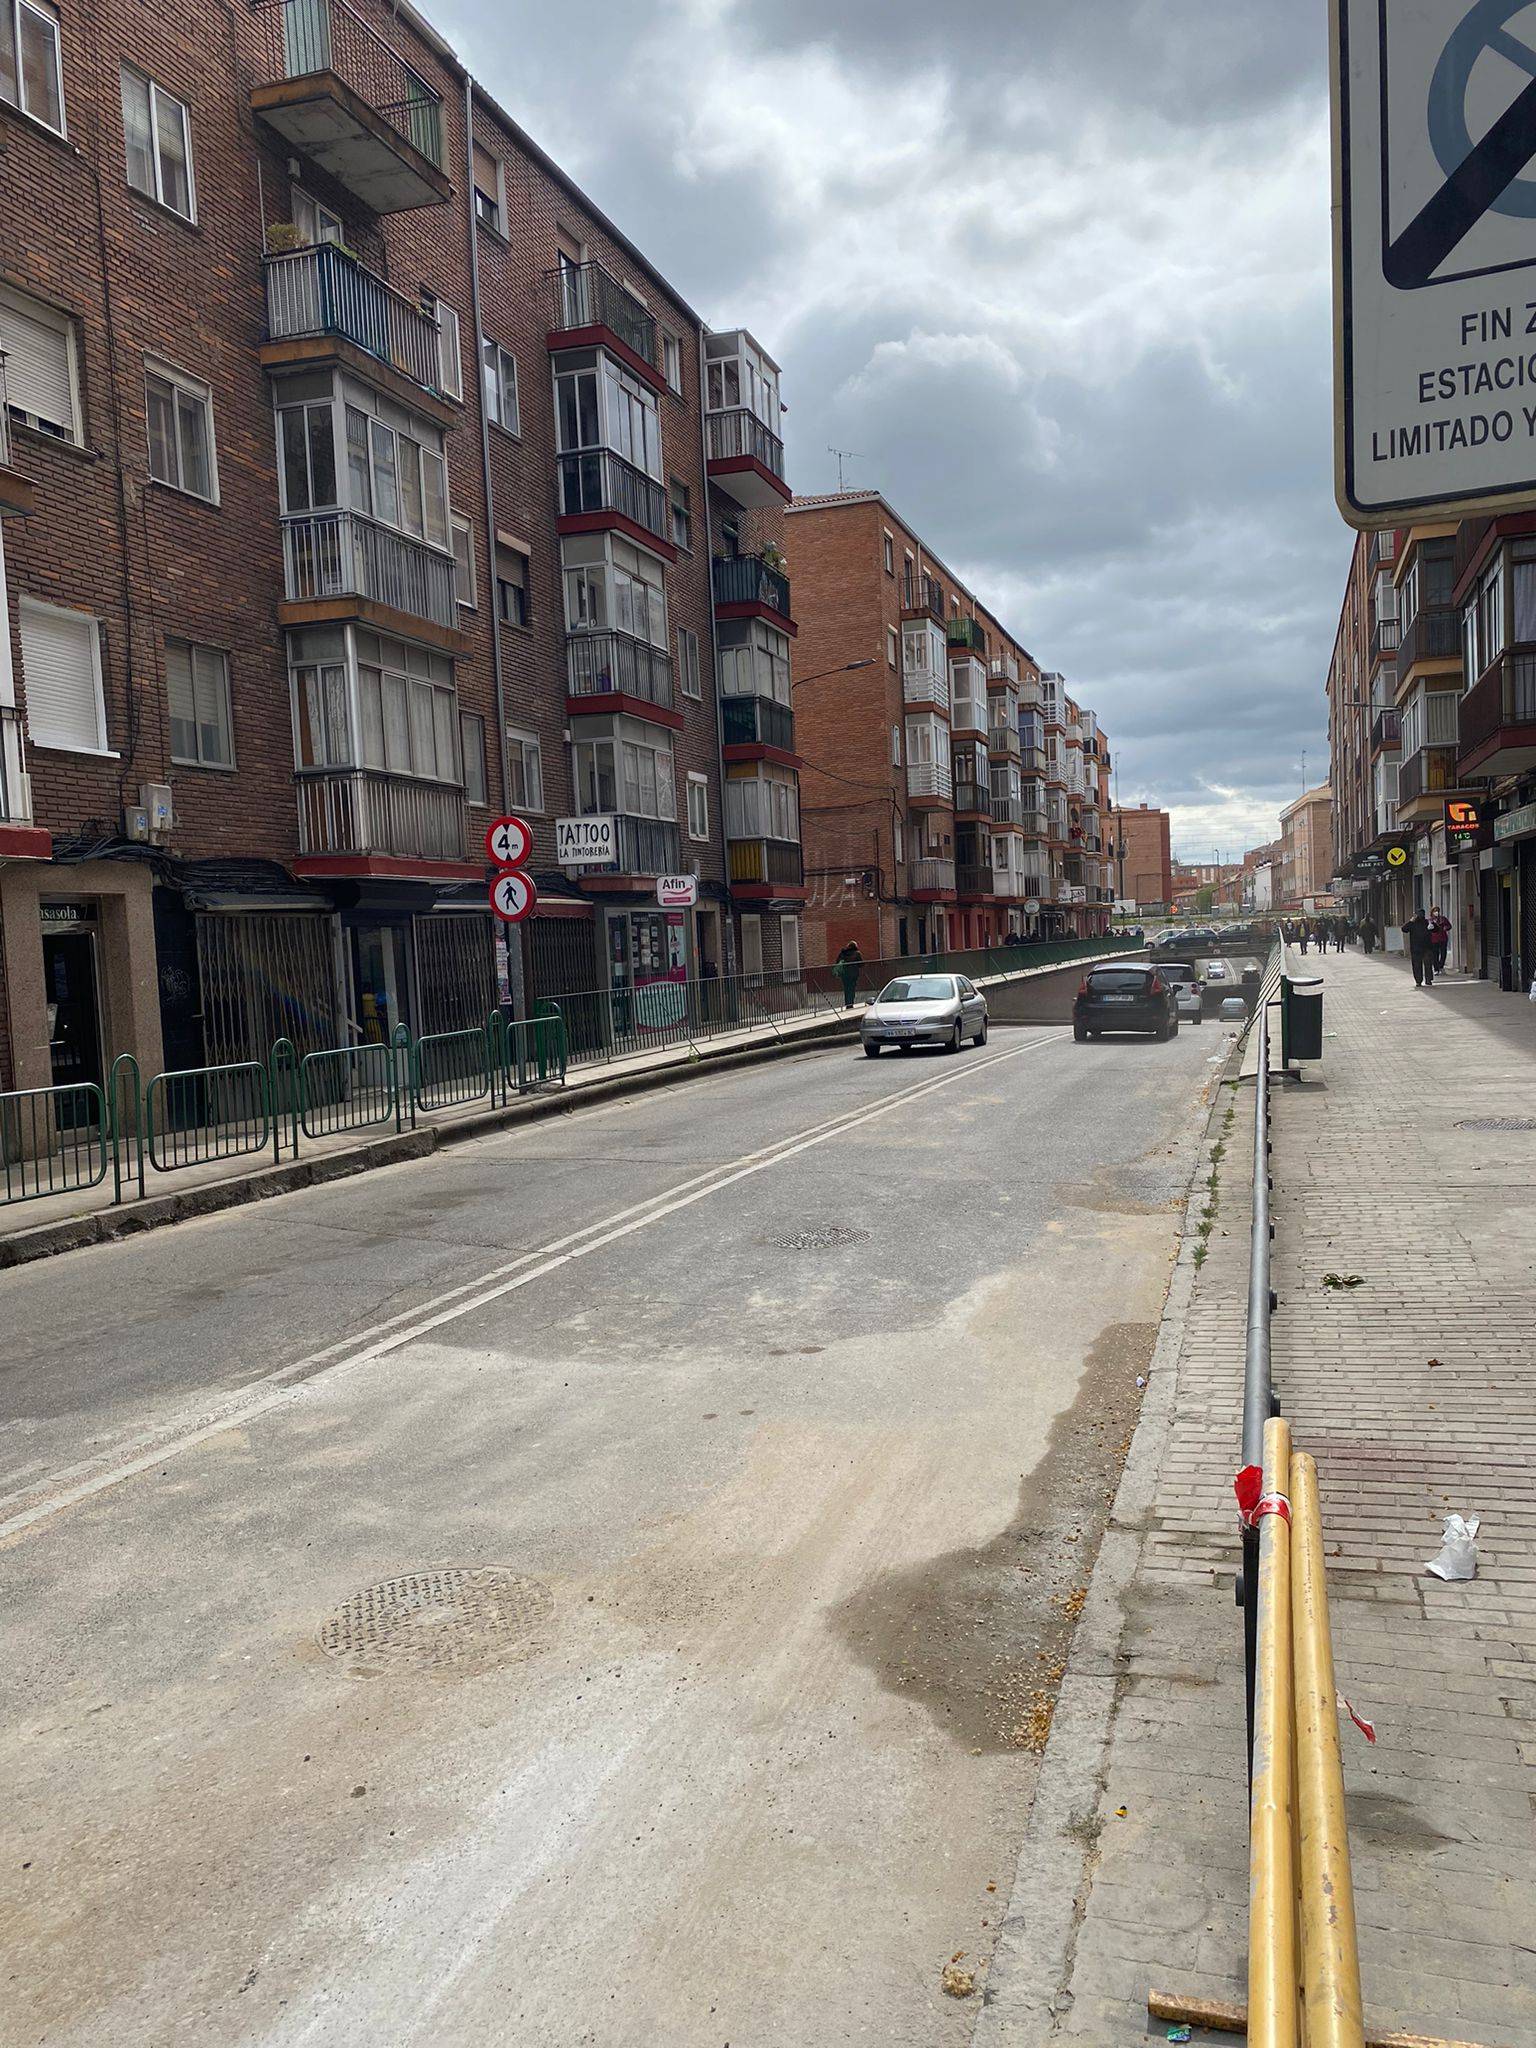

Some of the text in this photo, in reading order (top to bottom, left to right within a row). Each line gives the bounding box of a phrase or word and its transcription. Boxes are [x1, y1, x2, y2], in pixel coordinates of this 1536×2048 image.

[1461, 307, 1512, 345] FIN
[1372, 410, 1514, 462] LIMITADO
[498, 833, 510, 850] 4
[557, 823, 610, 846] TATTOO
[559, 848, 569, 858] LA
[662, 879, 686, 890] Afin
